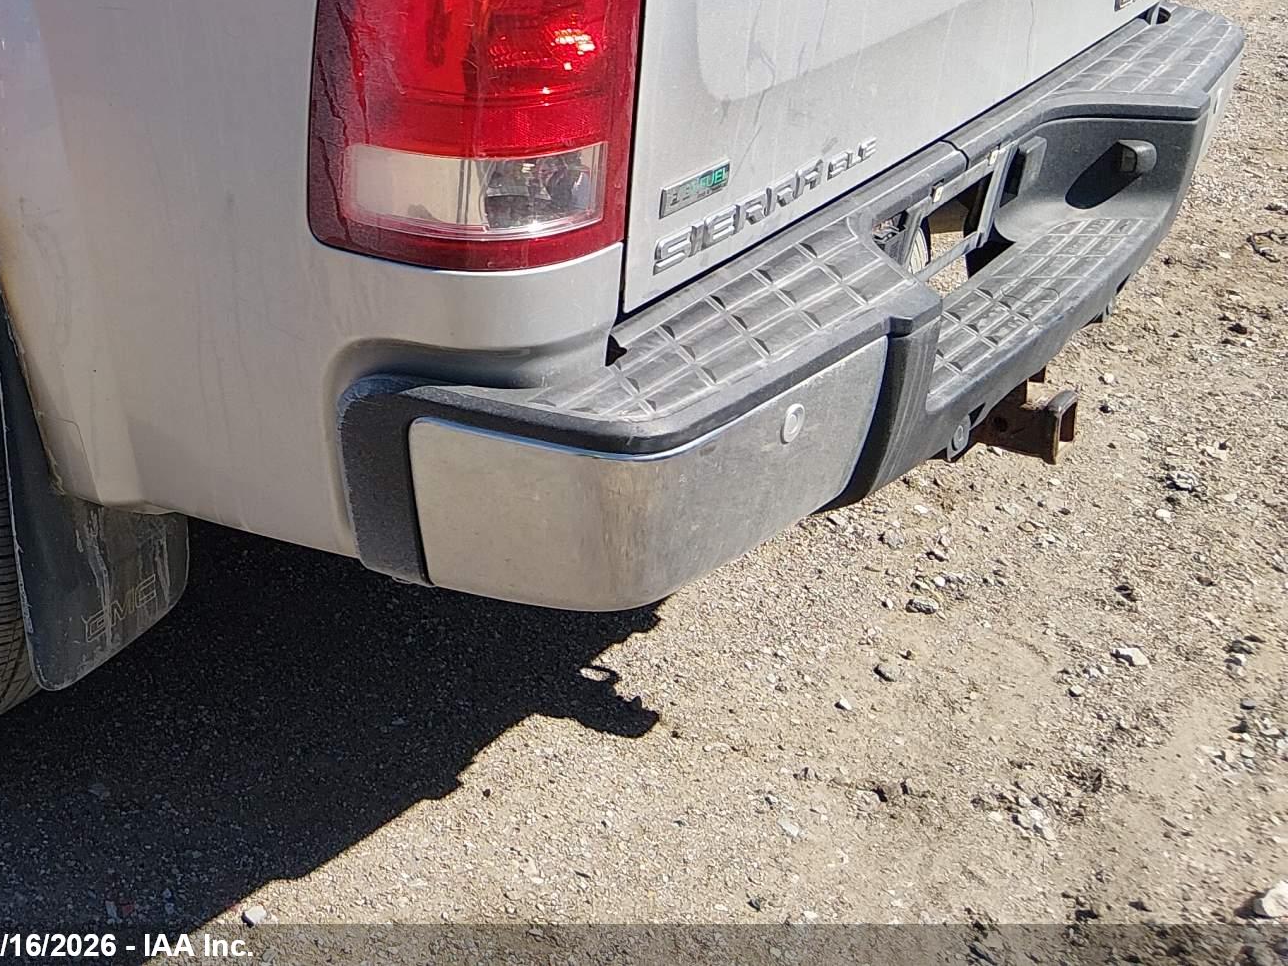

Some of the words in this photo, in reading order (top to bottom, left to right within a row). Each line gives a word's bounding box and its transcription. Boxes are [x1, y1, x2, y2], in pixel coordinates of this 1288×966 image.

[653, 157, 825, 276] SIERRA
[826, 136, 878, 181] SLE
[85, 572, 157, 643] GMC
